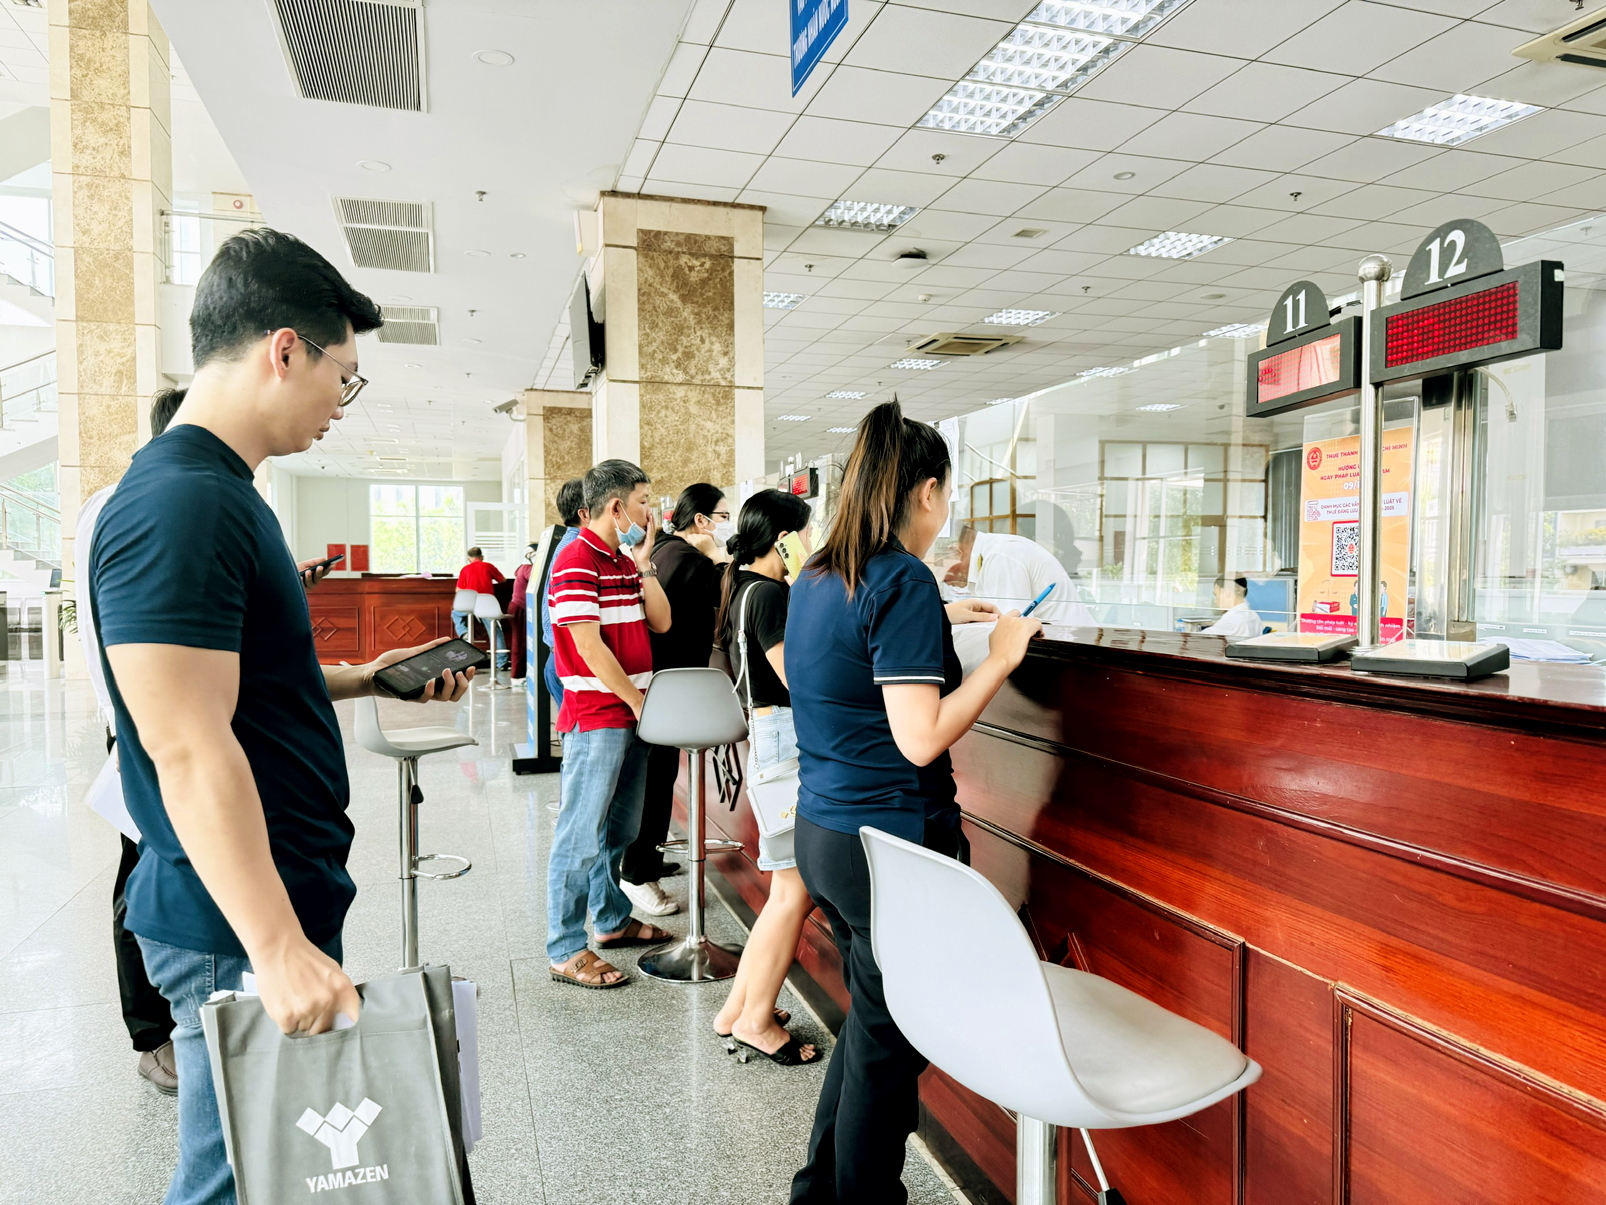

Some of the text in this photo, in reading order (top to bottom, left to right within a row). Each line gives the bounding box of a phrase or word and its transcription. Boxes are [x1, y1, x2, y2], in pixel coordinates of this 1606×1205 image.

[1424, 229, 1468, 285] 12
[1282, 289, 1309, 335] 11
[305, 1164, 390, 1194] YAMAZEN
